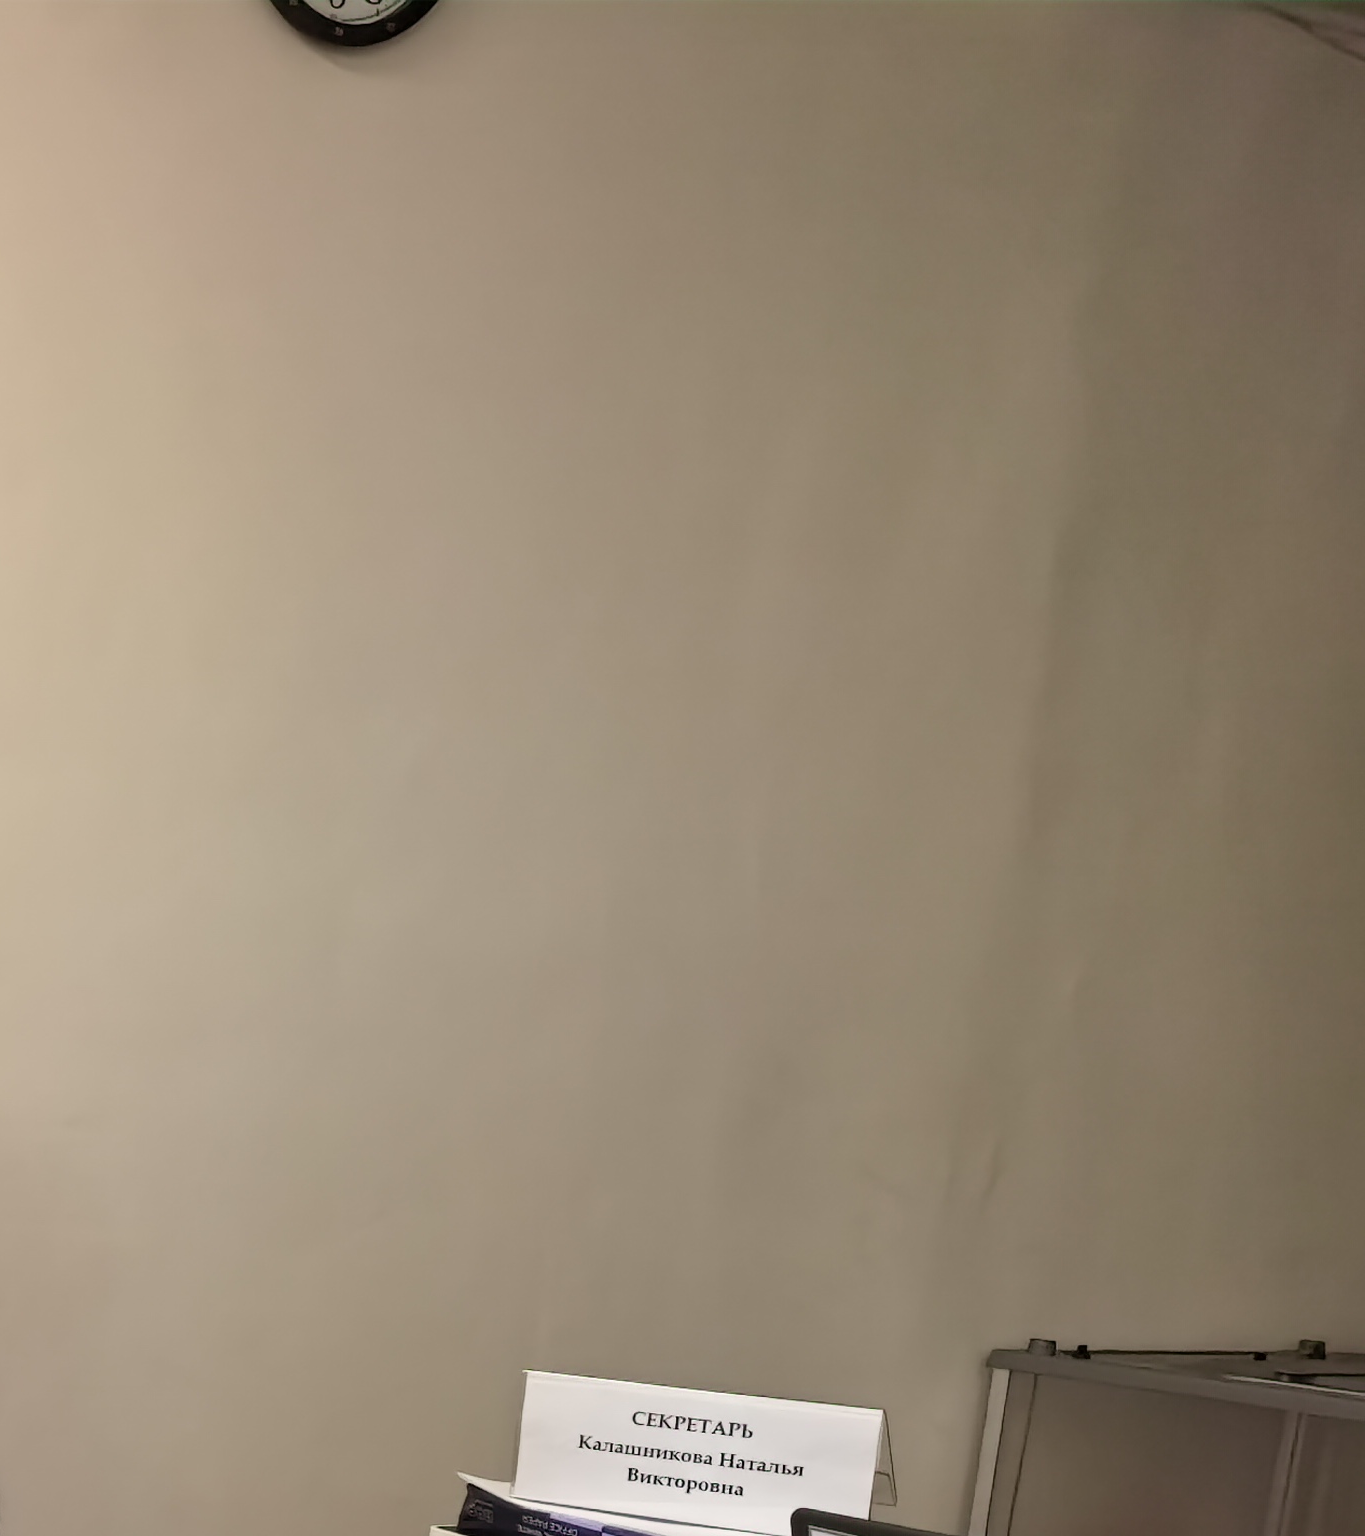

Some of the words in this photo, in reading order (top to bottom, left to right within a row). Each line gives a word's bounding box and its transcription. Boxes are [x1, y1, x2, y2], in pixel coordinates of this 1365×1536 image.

[632, 1411, 754, 1439] СЕКРЕТАРЬ
[578, 1434, 713, 1466] Калашникова
[719, 1452, 805, 1477] Наталья
[627, 1467, 744, 1497] Викторовна
